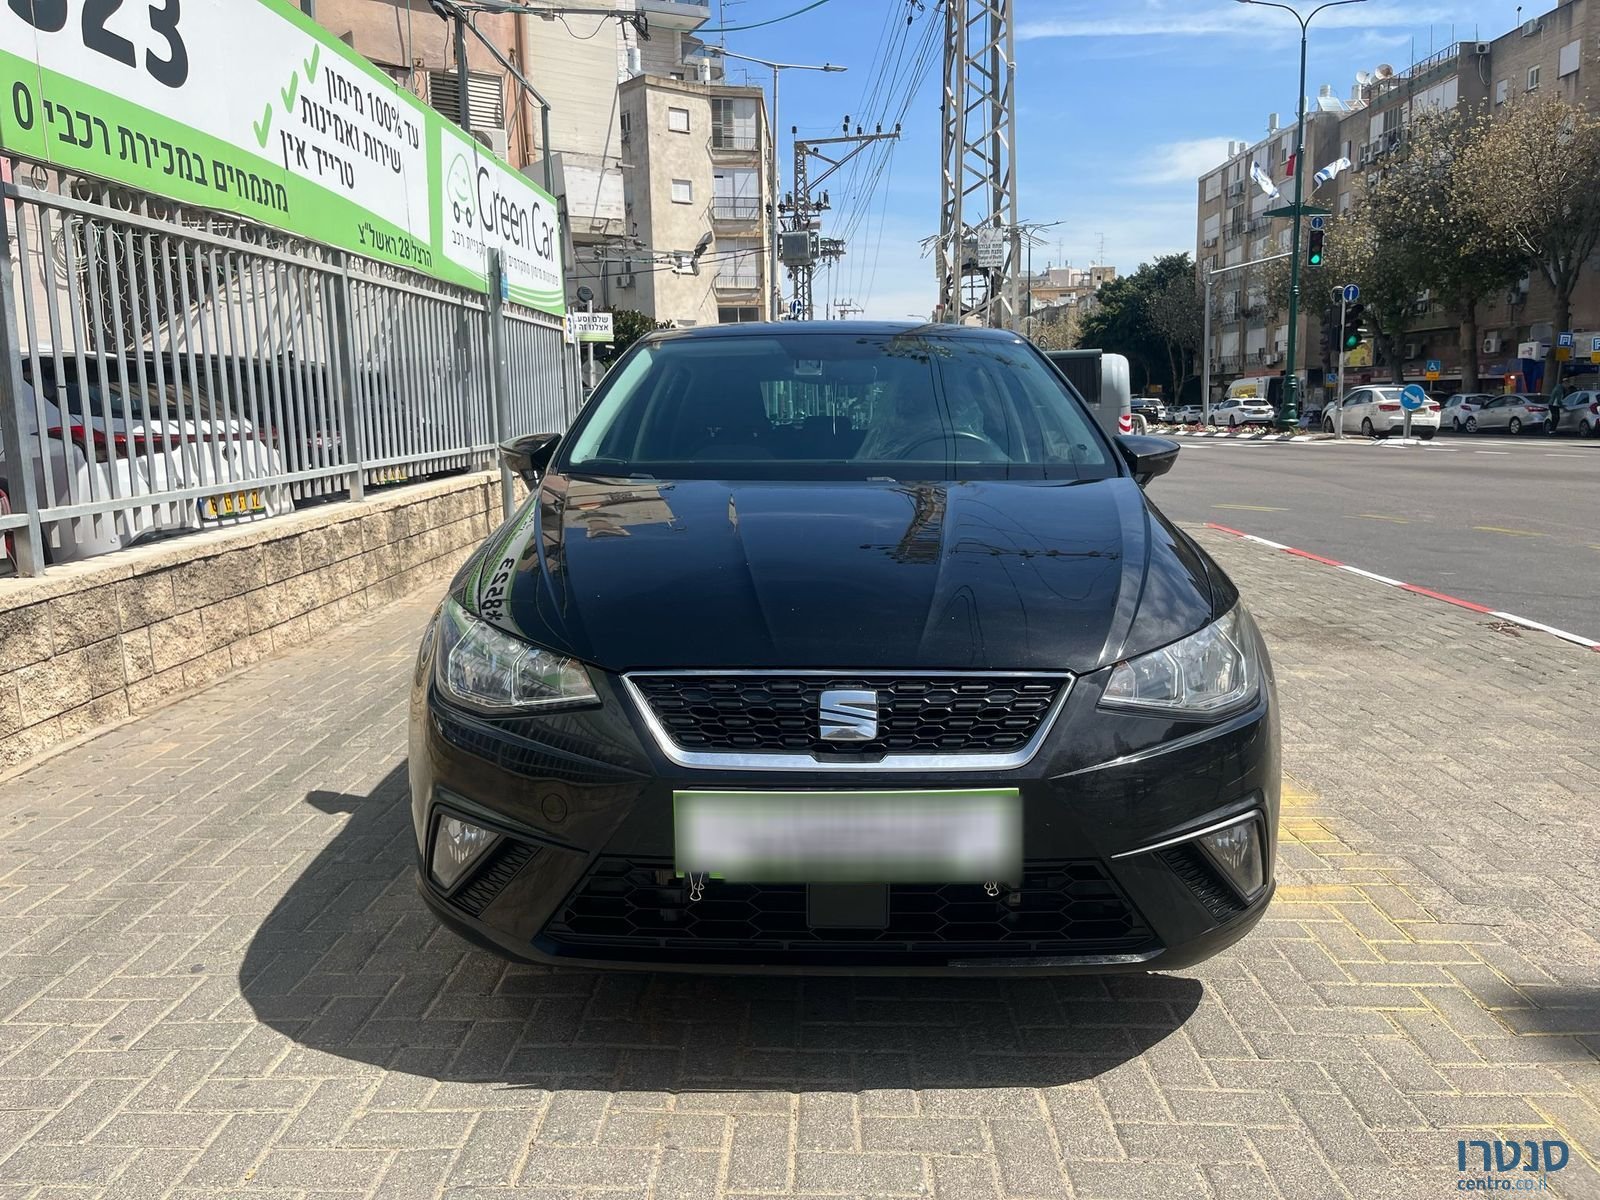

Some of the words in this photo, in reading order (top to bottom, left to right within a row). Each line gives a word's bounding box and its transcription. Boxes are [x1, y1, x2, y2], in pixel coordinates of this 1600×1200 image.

[12, 81, 34, 131] 0
[325, 66, 364, 116] מימון
[43, 99, 111, 156] רכבי
[300, 95, 360, 153] ואמינות
[367, 92, 402, 139] 100%
[403, 120, 419, 150] עד
[117, 125, 208, 187] במכירת
[280, 129, 309, 171] אין
[312, 145, 354, 190] טרייד
[363, 131, 401, 174] שירות
[212, 159, 289, 213] מתמחים
[476, 166, 530, 250] Green
[531, 202, 554, 263] Car
[398, 236, 411, 260] 28
[411, 240, 433, 268] הרצל
[452, 230, 464, 248] רכב
[589, 323, 609, 331] אצלנו
[592, 315, 609, 323] שלם
